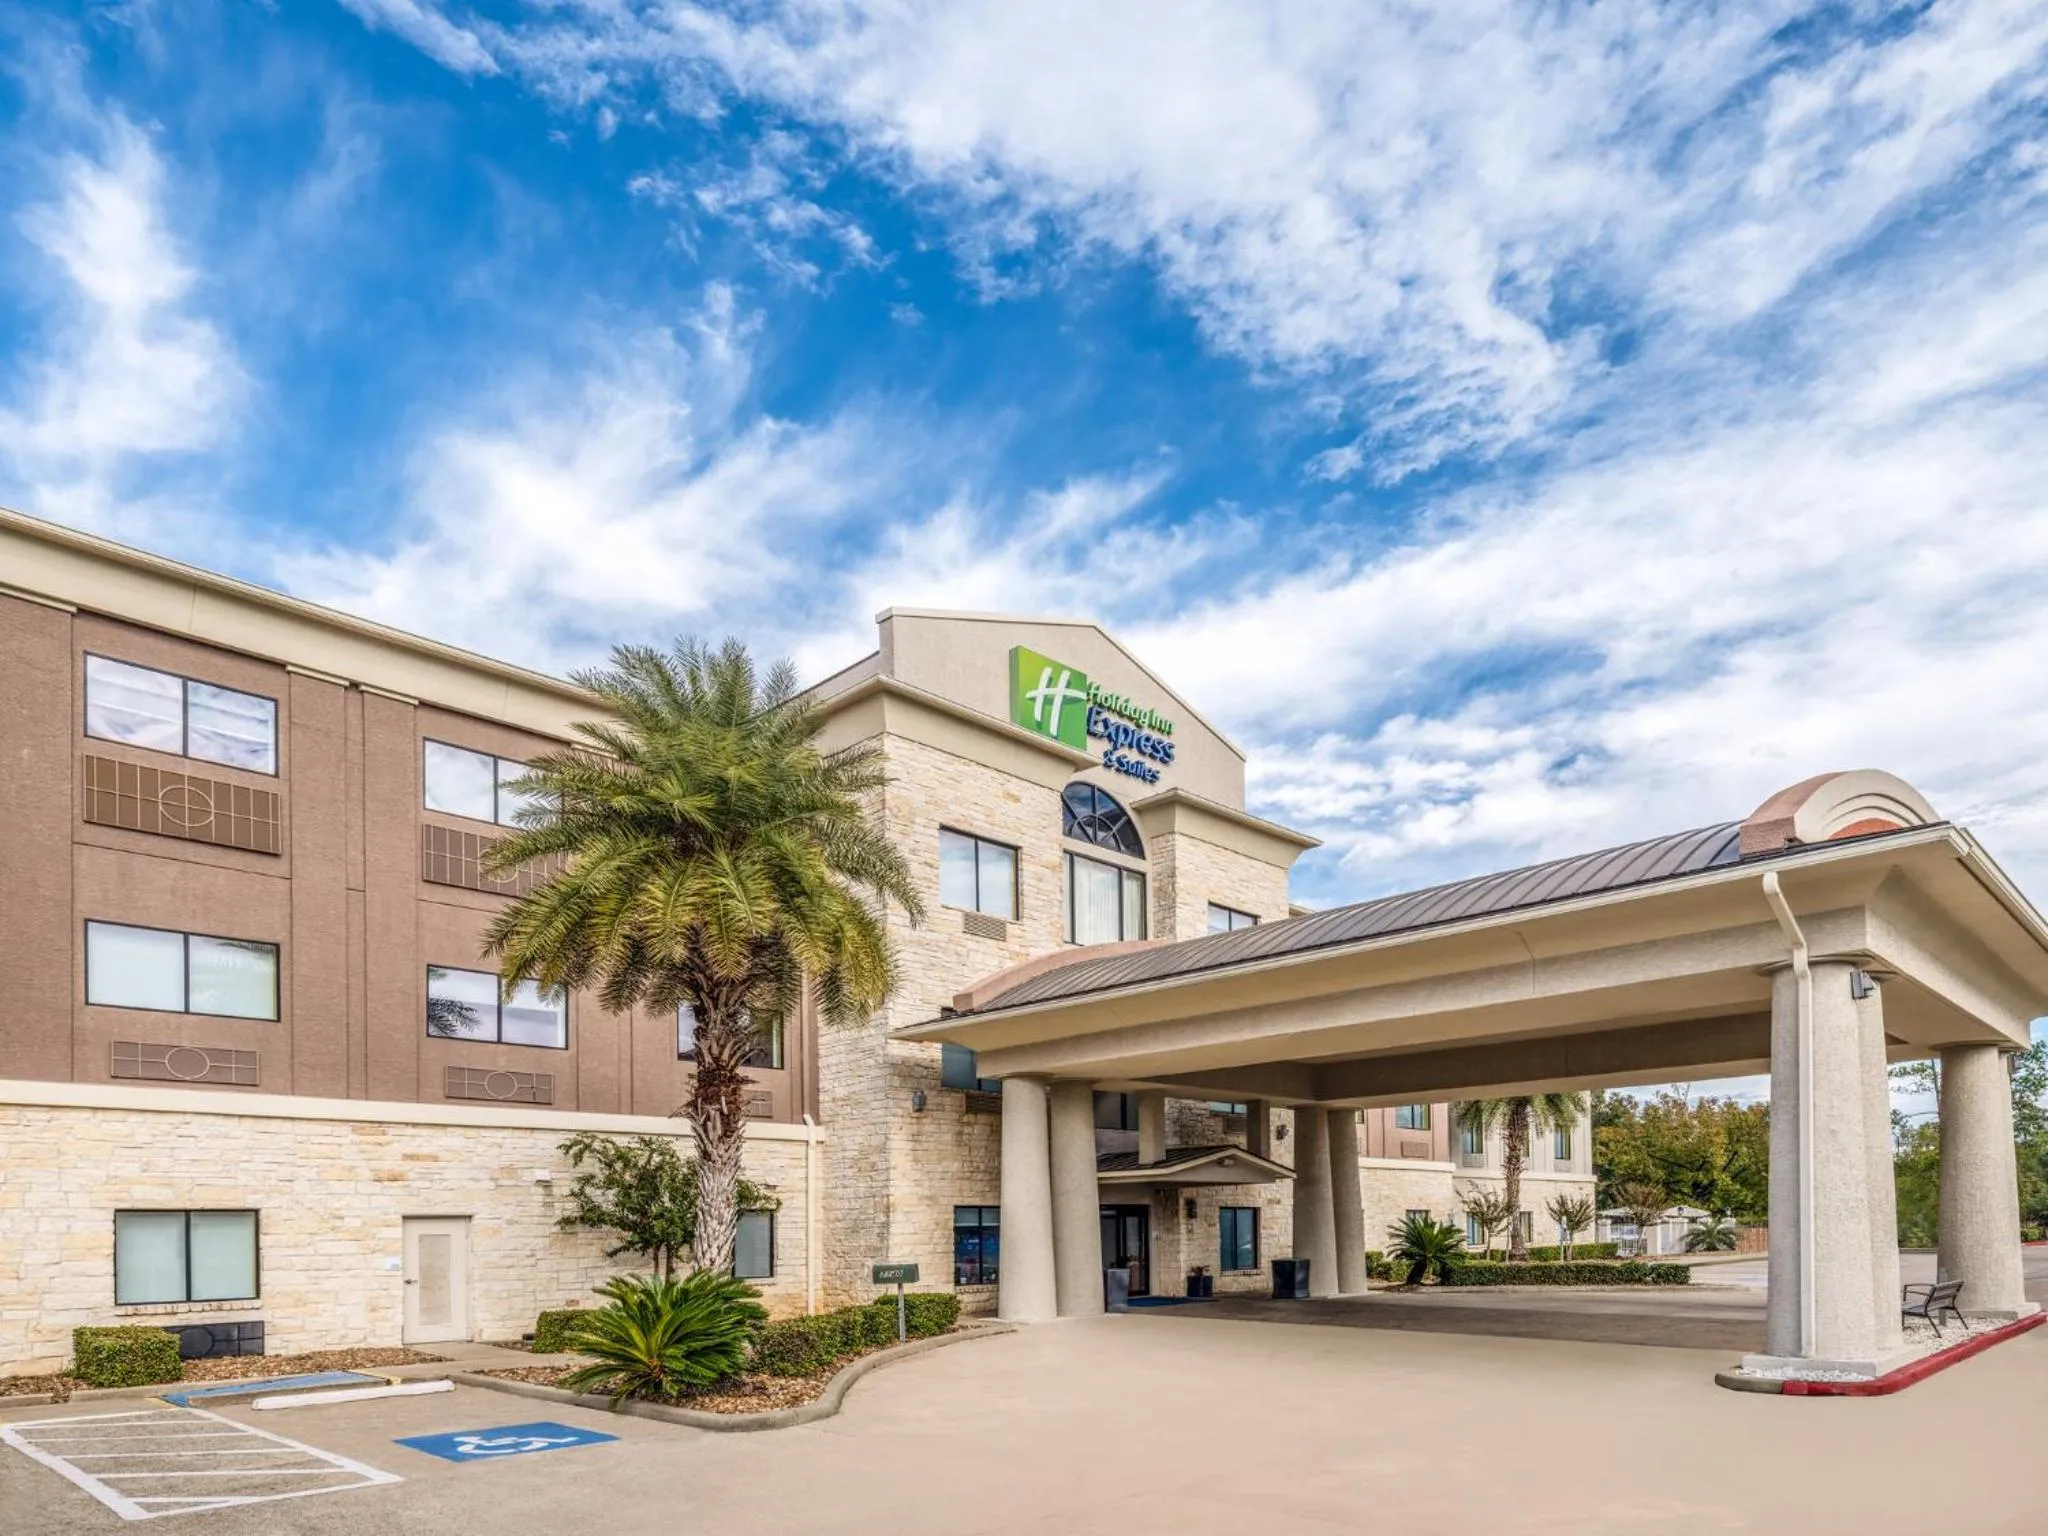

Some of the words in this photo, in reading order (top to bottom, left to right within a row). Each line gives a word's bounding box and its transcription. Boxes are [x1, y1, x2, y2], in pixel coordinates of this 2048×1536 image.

[1087, 705, 1176, 764] Express
[1088, 682, 1151, 727] Holiday
[1151, 707, 1176, 735] Inn
[1103, 749, 1115, 768] &
[1114, 753, 1161, 784] Suites
